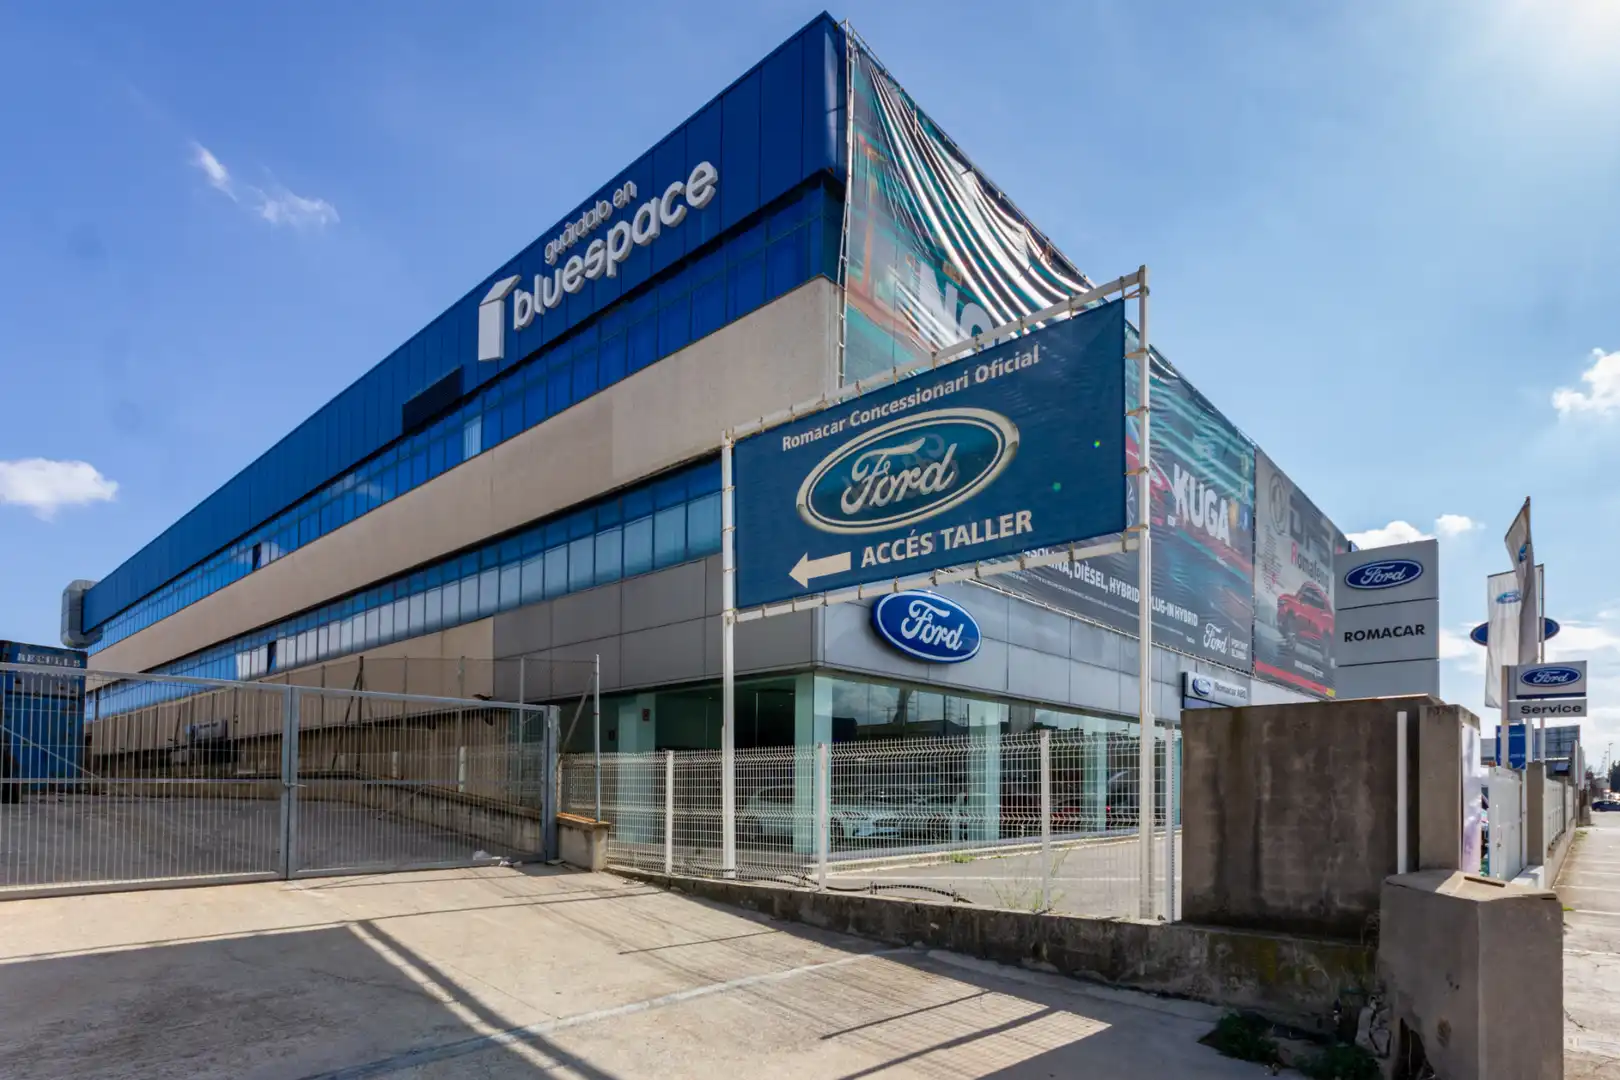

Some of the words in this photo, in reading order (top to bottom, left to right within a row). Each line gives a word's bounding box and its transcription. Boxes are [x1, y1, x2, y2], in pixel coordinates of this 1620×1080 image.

[613, 180, 638, 209] en
[513, 161, 718, 331] bluespace
[782, 417, 847, 451] Romacar
[849, 370, 969, 427] Concessionari
[975, 344, 1040, 383] Oficial
[840, 437, 958, 515] Ford
[1173, 463, 1231, 548] KUGA
[861, 529, 932, 568] ACCÉS
[940, 510, 1033, 550] TALLER
[1360, 564, 1407, 585] Ford
[901, 600, 964, 651] Ford
[1203, 623, 1228, 655] Ford
[1344, 624, 1425, 643] ROMACAR
[1533, 671, 1570, 683] Ford
[1520, 704, 1582, 715] Service
